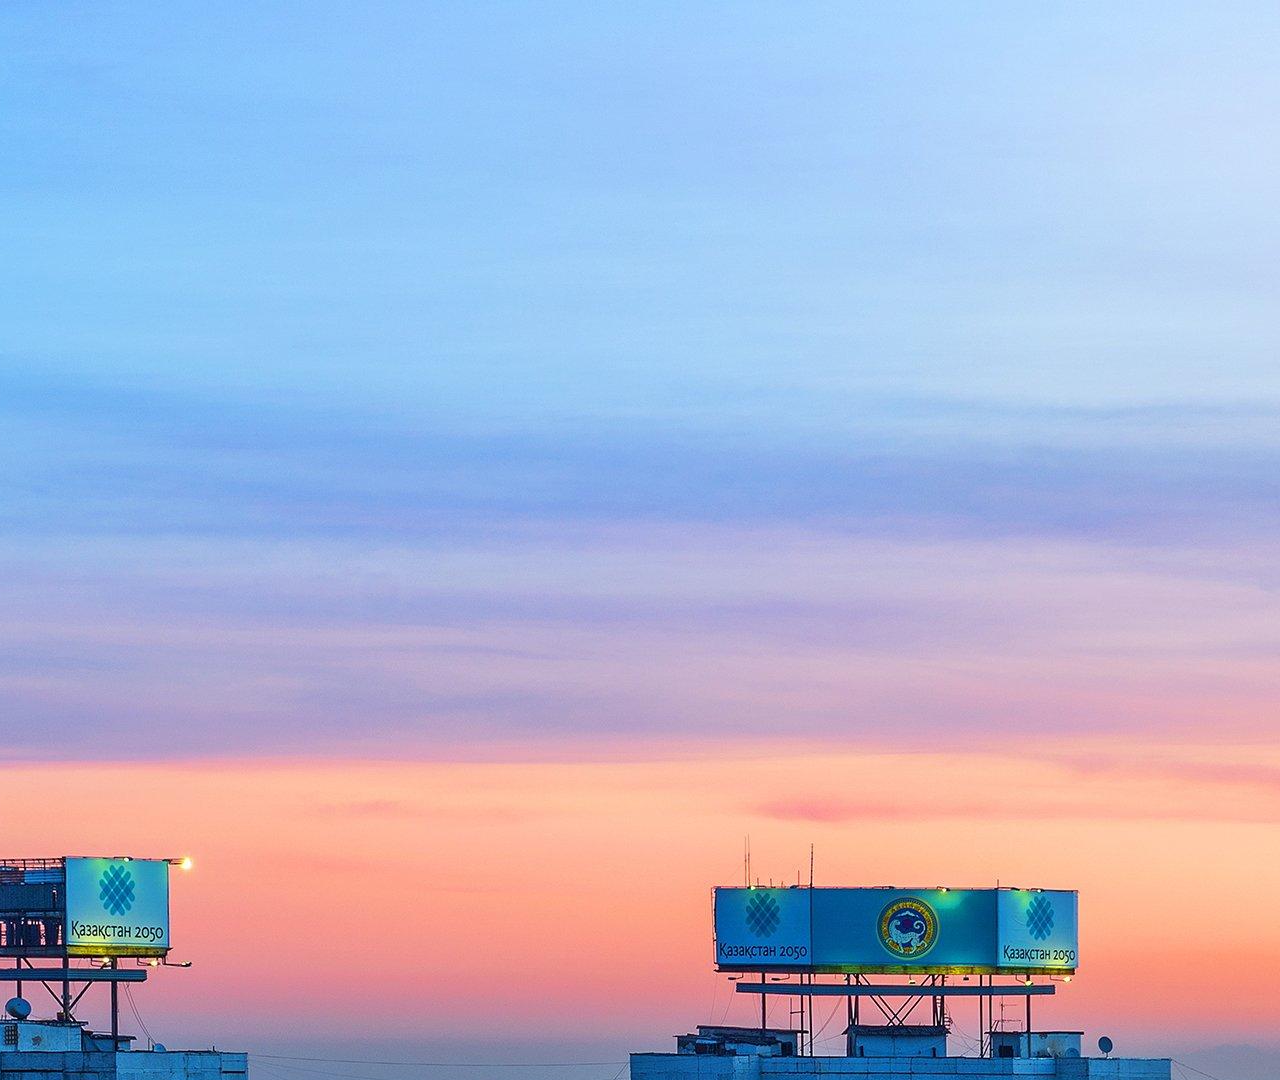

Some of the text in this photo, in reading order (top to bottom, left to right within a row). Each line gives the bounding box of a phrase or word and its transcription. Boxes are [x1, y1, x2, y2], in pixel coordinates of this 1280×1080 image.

[71, 920, 163, 942] Қазақстан 2050
[719, 942, 807, 960] Қазақстан 2050
[1003, 943, 1075, 963] Қазақстан 2050
